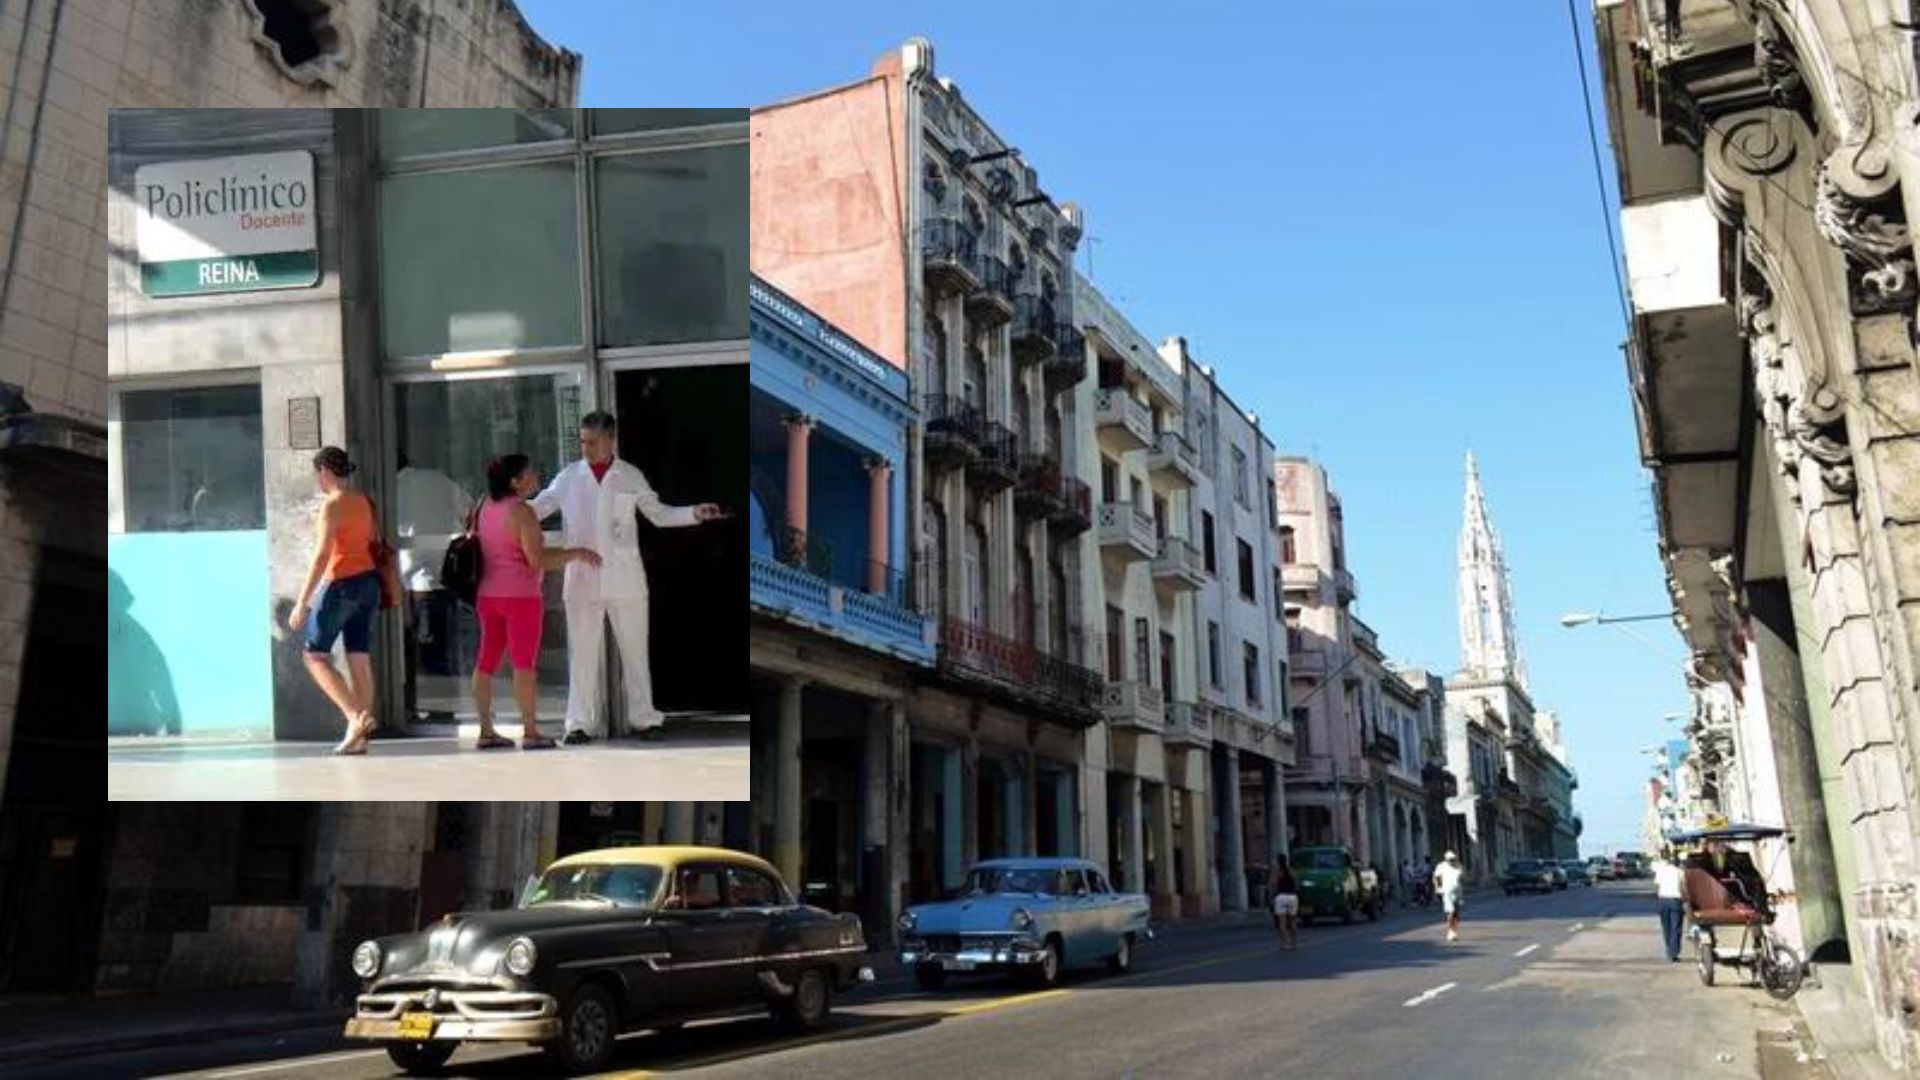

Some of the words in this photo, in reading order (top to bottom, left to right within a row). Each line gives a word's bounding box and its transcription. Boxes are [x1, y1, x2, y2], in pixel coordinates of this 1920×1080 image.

[144, 174, 306, 219] Policlínico
[240, 212, 305, 230] Docente
[198, 260, 260, 286] REINA
